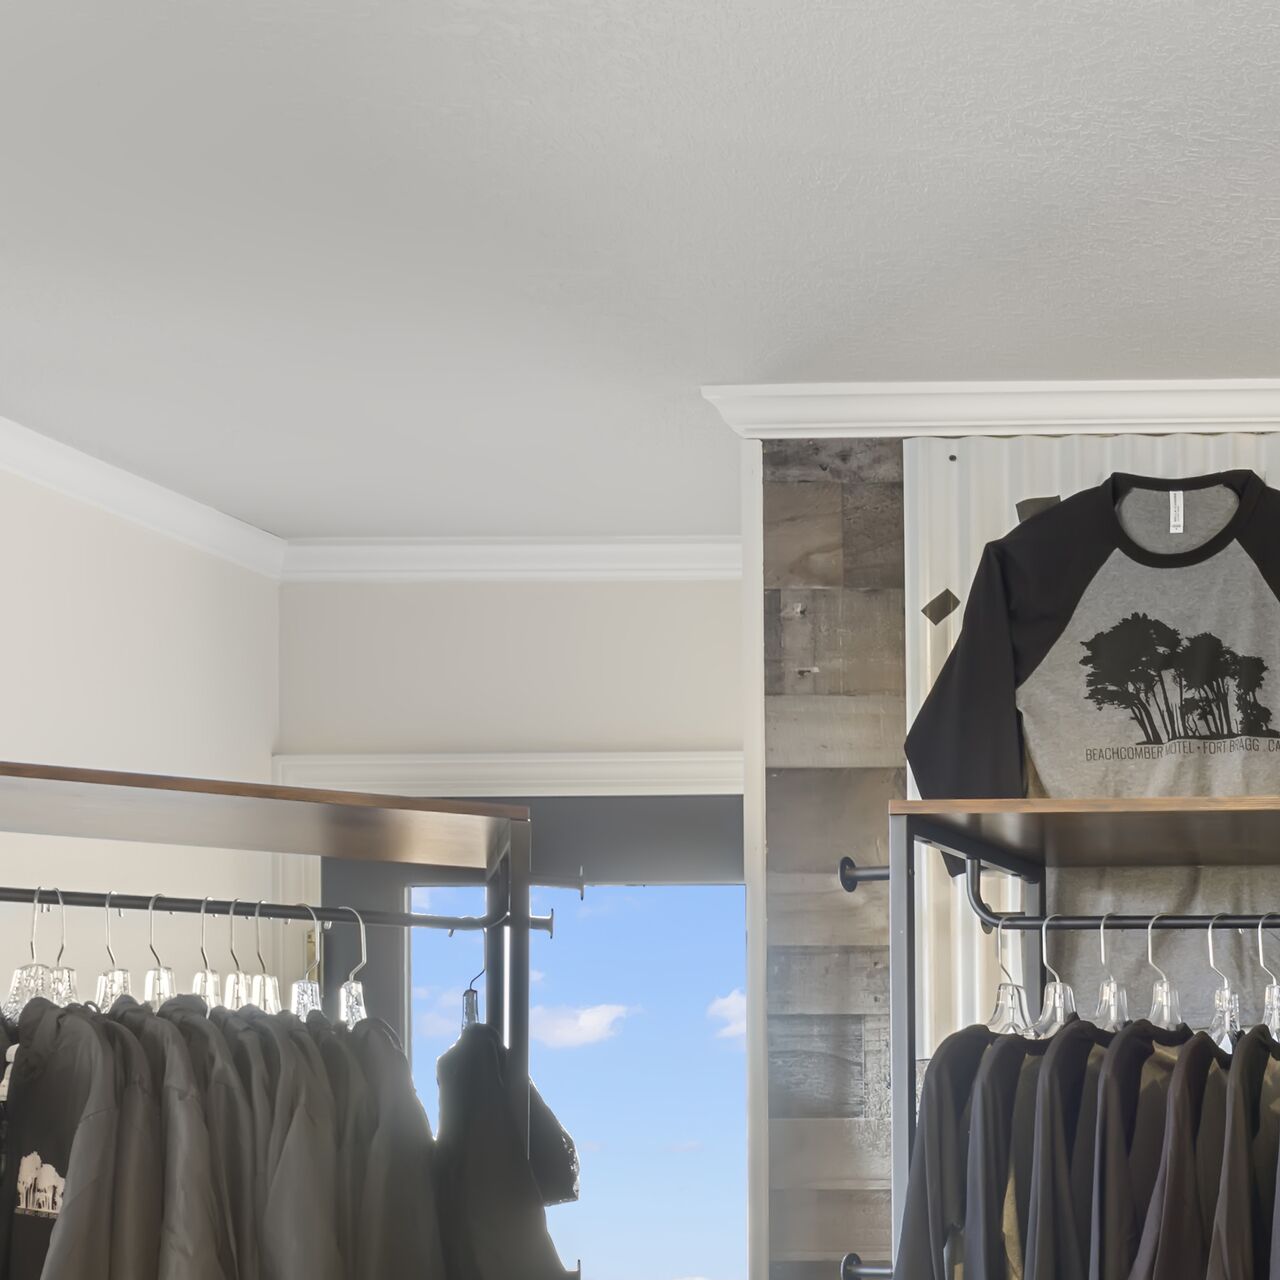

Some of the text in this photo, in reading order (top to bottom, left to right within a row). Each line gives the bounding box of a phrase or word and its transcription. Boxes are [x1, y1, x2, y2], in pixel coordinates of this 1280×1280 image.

[1086, 746, 1163, 761] BEACHCOMBER
[1166, 740, 1194, 755] MOTEL
[1203, 741, 1226, 754] FORT
[1230, 739, 1259, 753] BRAGG
